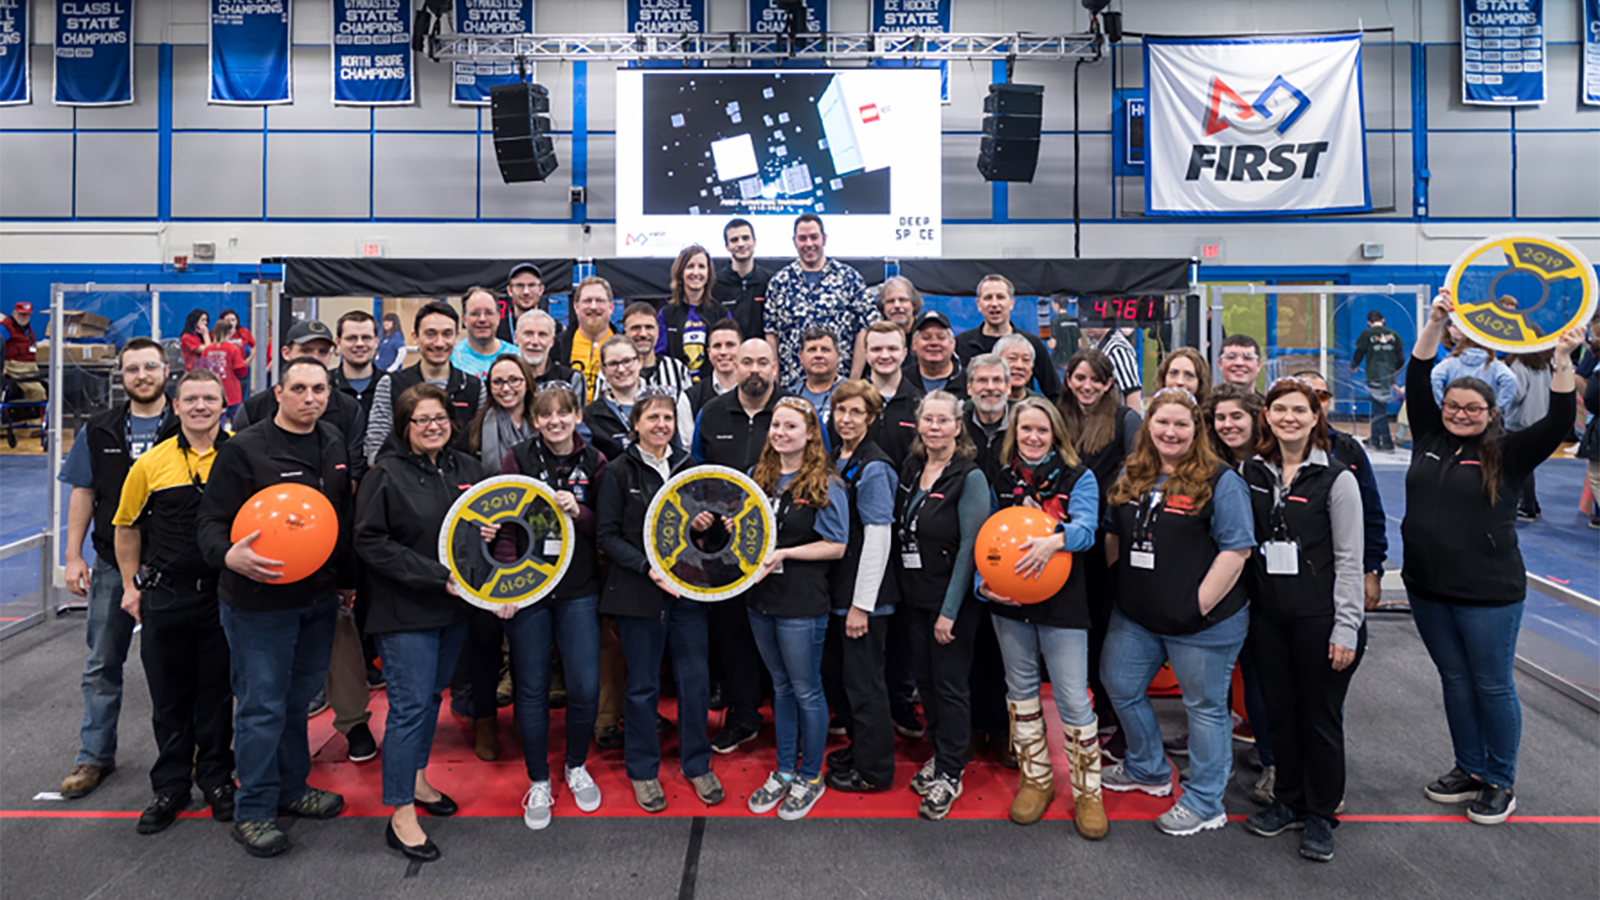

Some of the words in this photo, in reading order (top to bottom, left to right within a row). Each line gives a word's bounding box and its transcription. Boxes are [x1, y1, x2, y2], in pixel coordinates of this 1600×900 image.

[62, 2, 111, 14] CLASS
[114, 2, 125, 14] L
[218, 4, 283, 15] CHAMPIONS
[1476, 0, 1530, 11] STATE
[346, 9, 399, 22] STATE
[468, 9, 520, 21] STATE
[639, 8, 692, 21] STATE
[884, 12, 939, 25] STATE
[1469, 12, 1537, 25] CHAMPIONS
[66, 17, 121, 30] STATE
[339, 21, 404, 34] CHAMPIONS
[463, 20, 526, 33] CHAMPIONS
[634, 20, 699, 33] CHAMPIONS
[62, 31, 127, 45] CHAMPIONS
[341, 55, 371, 67] NORTH
[374, 54, 404, 67] SHORE
[341, 67, 406, 80] CHAMPIONS
[1185, 141, 1329, 181] FIRST
[899, 216, 930, 227] DEEP
[1522, 246, 1564, 269] 2019
[1474, 312, 1516, 336] 2019
[480, 491, 518, 513] 2019
[661, 509, 677, 548] 2019
[745, 517, 759, 556] 2019
[499, 571, 536, 593] 2019
